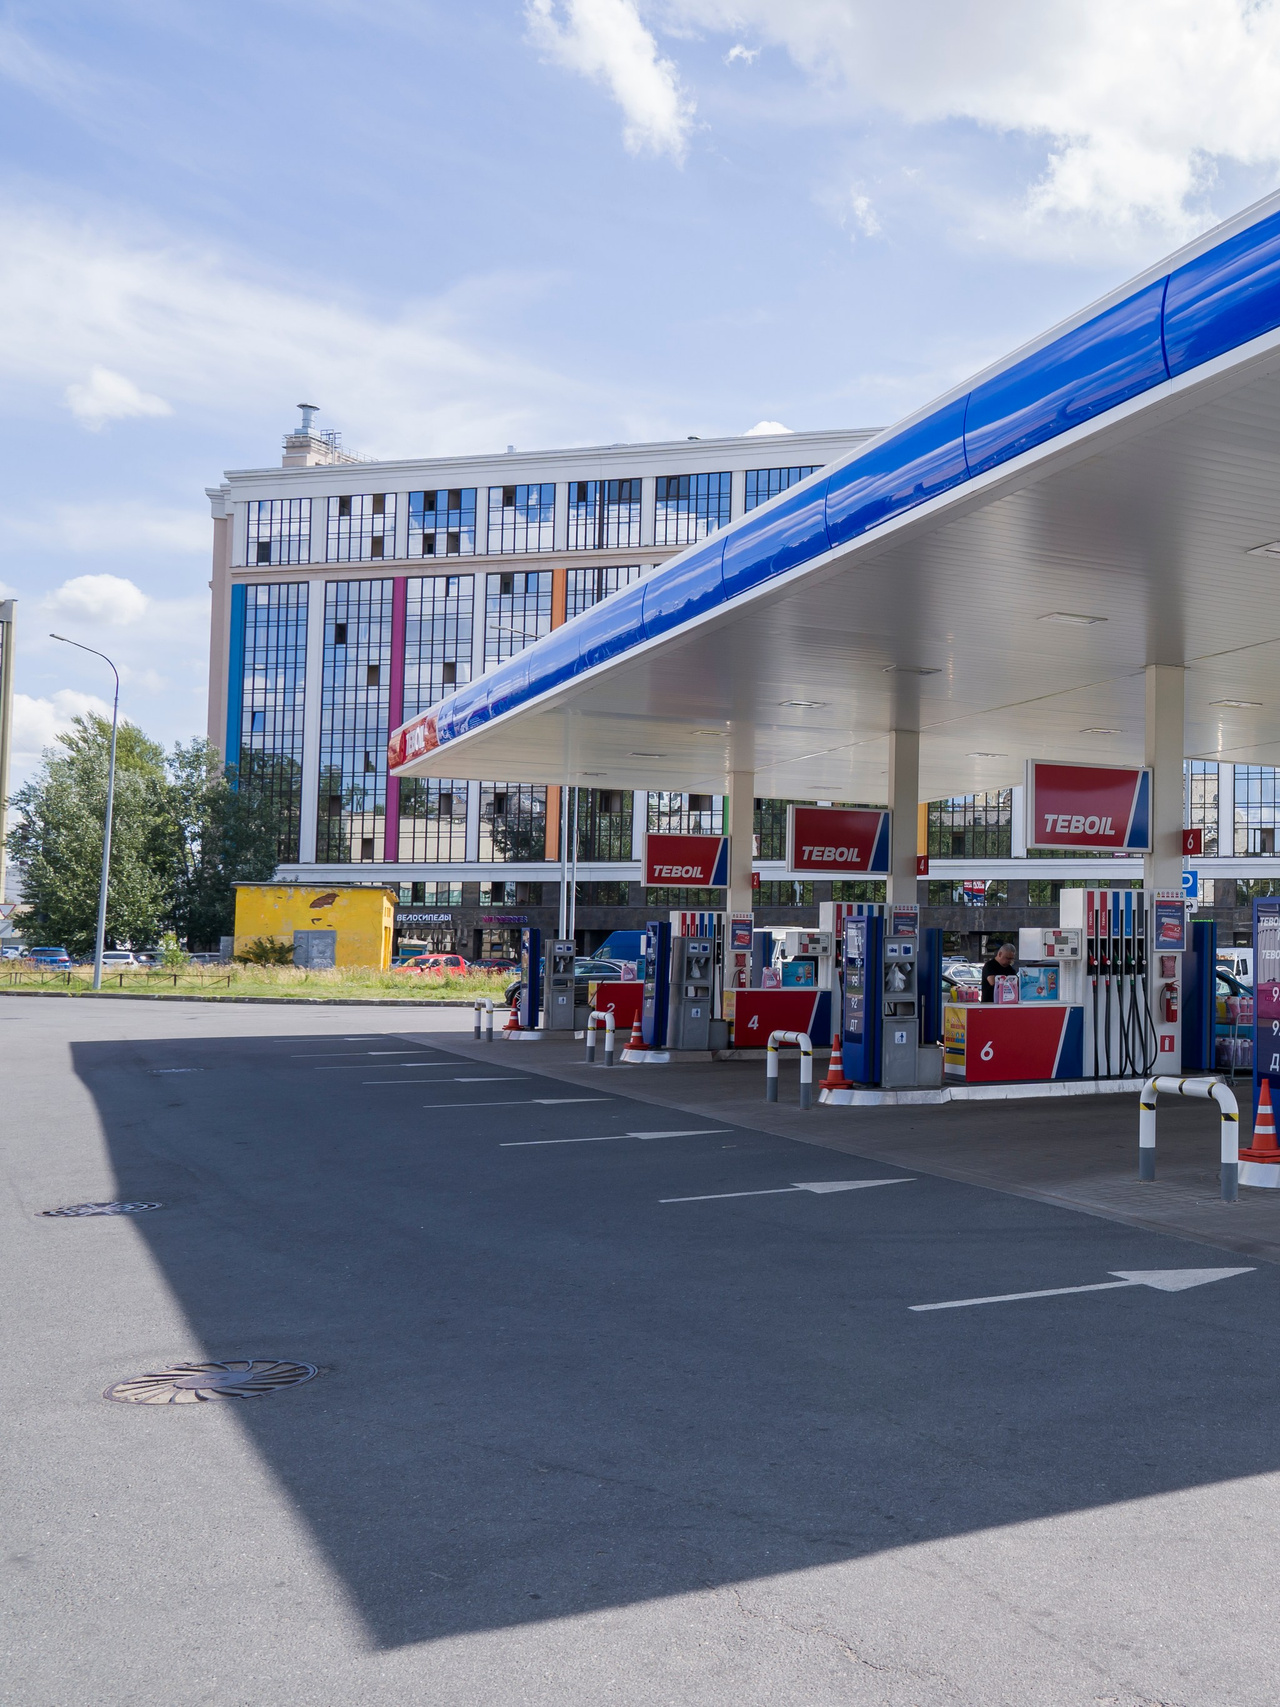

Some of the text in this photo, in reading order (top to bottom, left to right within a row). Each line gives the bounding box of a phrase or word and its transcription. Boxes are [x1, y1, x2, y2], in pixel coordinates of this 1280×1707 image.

[1044, 814, 1116, 836] TEBOIL
[1187, 834, 1194, 849] 6
[802, 846, 861, 862] TEBOIL
[653, 865, 704, 878] TEBOIL
[920, 863, 924, 872] 4
[753, 876, 758, 886] 2
[396, 914, 452, 922] ВЕЛОСИПЕДЫ
[851, 997, 858, 1008] 92
[748, 1015, 759, 1030] 4
[849, 1019, 858, 1032] ДТ
[980, 1040, 994, 1061] 6
